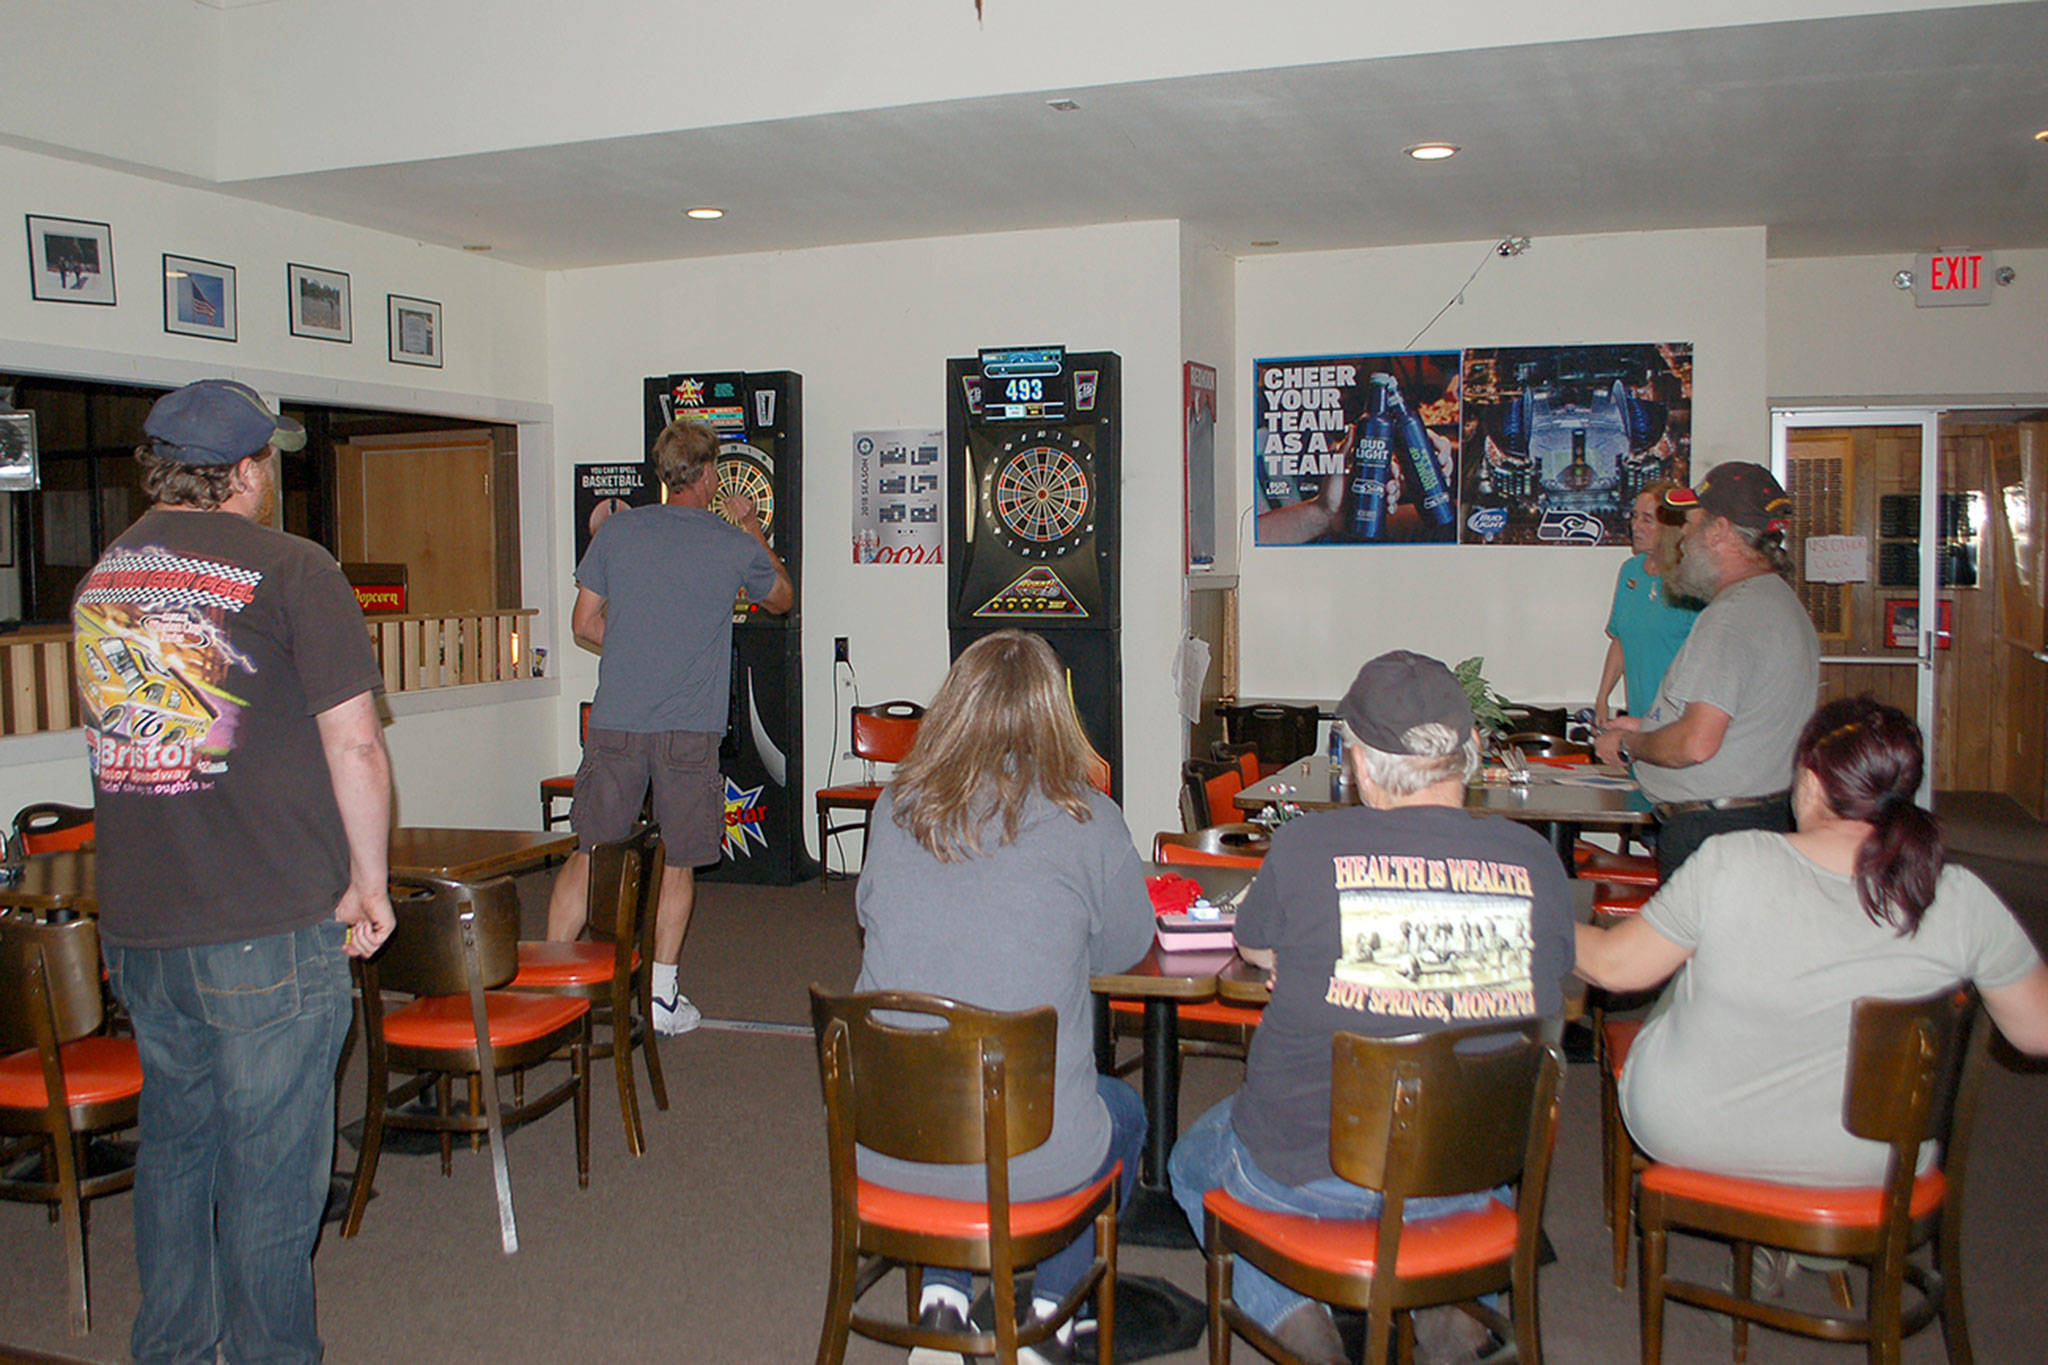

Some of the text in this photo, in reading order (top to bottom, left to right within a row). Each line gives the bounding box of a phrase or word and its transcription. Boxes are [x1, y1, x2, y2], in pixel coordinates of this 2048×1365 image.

[1931, 255, 1983, 290] EXIT
[1264, 365, 1357, 389] CHEER
[1005, 379, 1043, 401] 493
[1264, 388, 1341, 410] YOUR
[1264, 410, 1349, 433] TEAM,
[1264, 432, 1329, 454] AS A
[1355, 448, 1389, 460] LIGHT
[1360, 439, 1386, 450] BUD
[1264, 454, 1350, 475] TEAM.
[582, 475, 644, 488] BASKETBALL
[861, 459, 869, 495] SEASON
[1474, 519, 1505, 528] LIGHT
[1480, 513, 1504, 521] BUD
[101, 736, 193, 769] Bristol
[1333, 855, 1534, 898] HEALTH IS WEALTH
[1325, 976, 1369, 1012] HOT
[1367, 988, 1450, 1024] SPRINGS,
